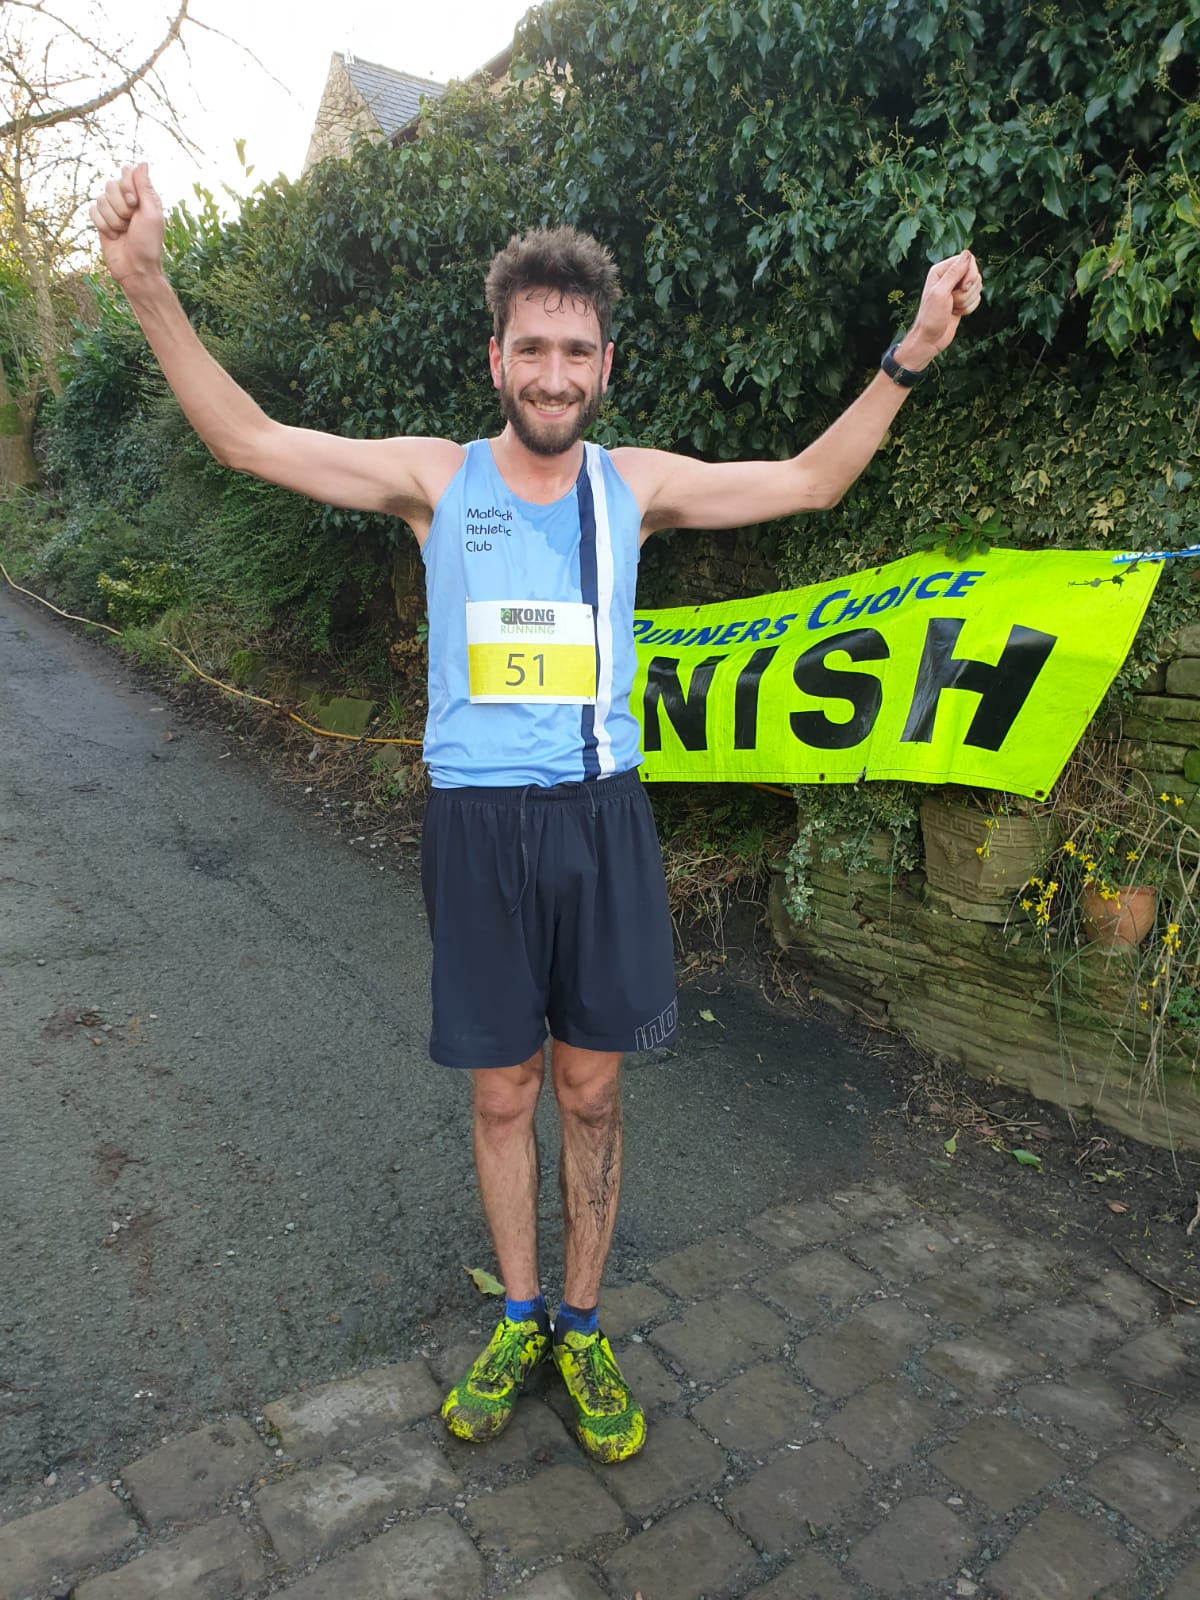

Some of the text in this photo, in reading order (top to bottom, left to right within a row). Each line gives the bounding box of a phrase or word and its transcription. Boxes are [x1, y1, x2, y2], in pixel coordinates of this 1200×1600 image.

[466, 506, 512, 521] Matlock
[466, 523, 512, 537] Athletic
[465, 540, 493, 552] Club
[501, 624, 555, 634] RUNNING
[505, 653, 544, 686] 51
[643, 617, 1058, 752] NISH
